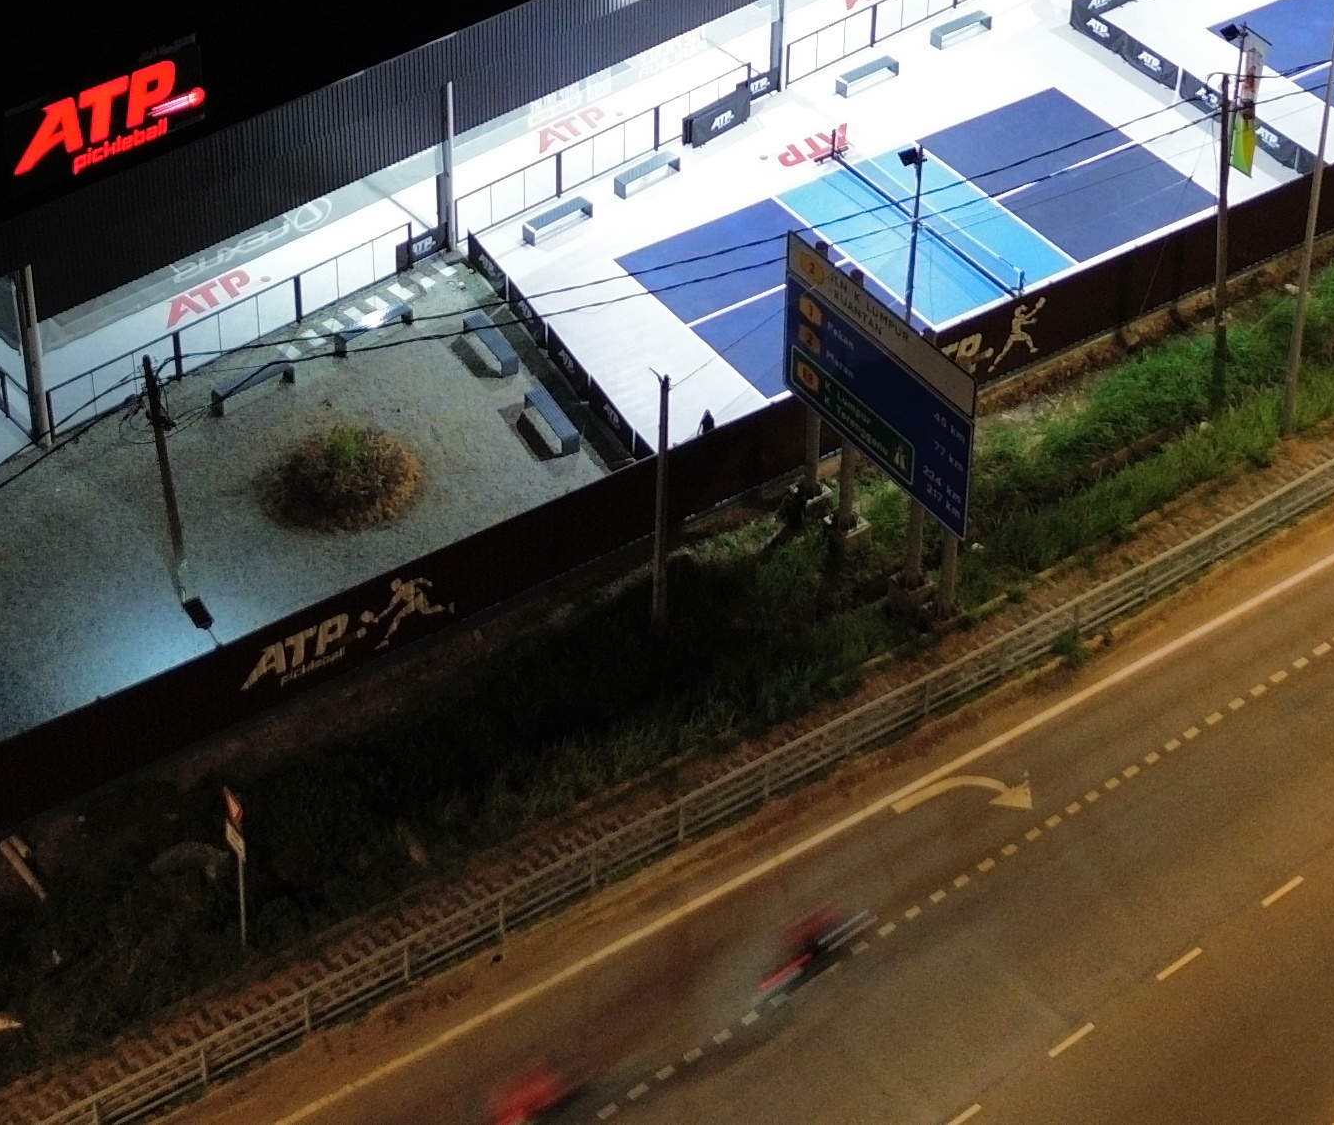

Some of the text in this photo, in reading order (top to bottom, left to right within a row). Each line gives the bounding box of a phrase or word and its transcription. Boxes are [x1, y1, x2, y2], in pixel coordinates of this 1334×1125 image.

[1086, 17, 1109, 35] ATP
[1137, 50, 1161, 69] ATP
[14, 60, 176, 176] ATP
[539, 106, 605, 154] ATP
[711, 109, 732, 131] ATP
[72, 117, 168, 176] pickleball
[778, 122, 848, 167] ATP
[1255, 127, 1279, 144] ATP
[809, 262, 815, 275] 2
[167, 269, 251, 328] ATP
[834, 290, 882, 336] KUANTAN
[827, 321, 855, 351] Pekan
[866, 302, 909, 340] LUMPUR
[826, 350, 855, 379] Maran
[950, 424, 965, 444] km
[934, 439, 964, 473] 77 km
[946, 499, 961, 519] km
[947, 484, 962, 505] km
[240, 613, 349, 691] ATP
